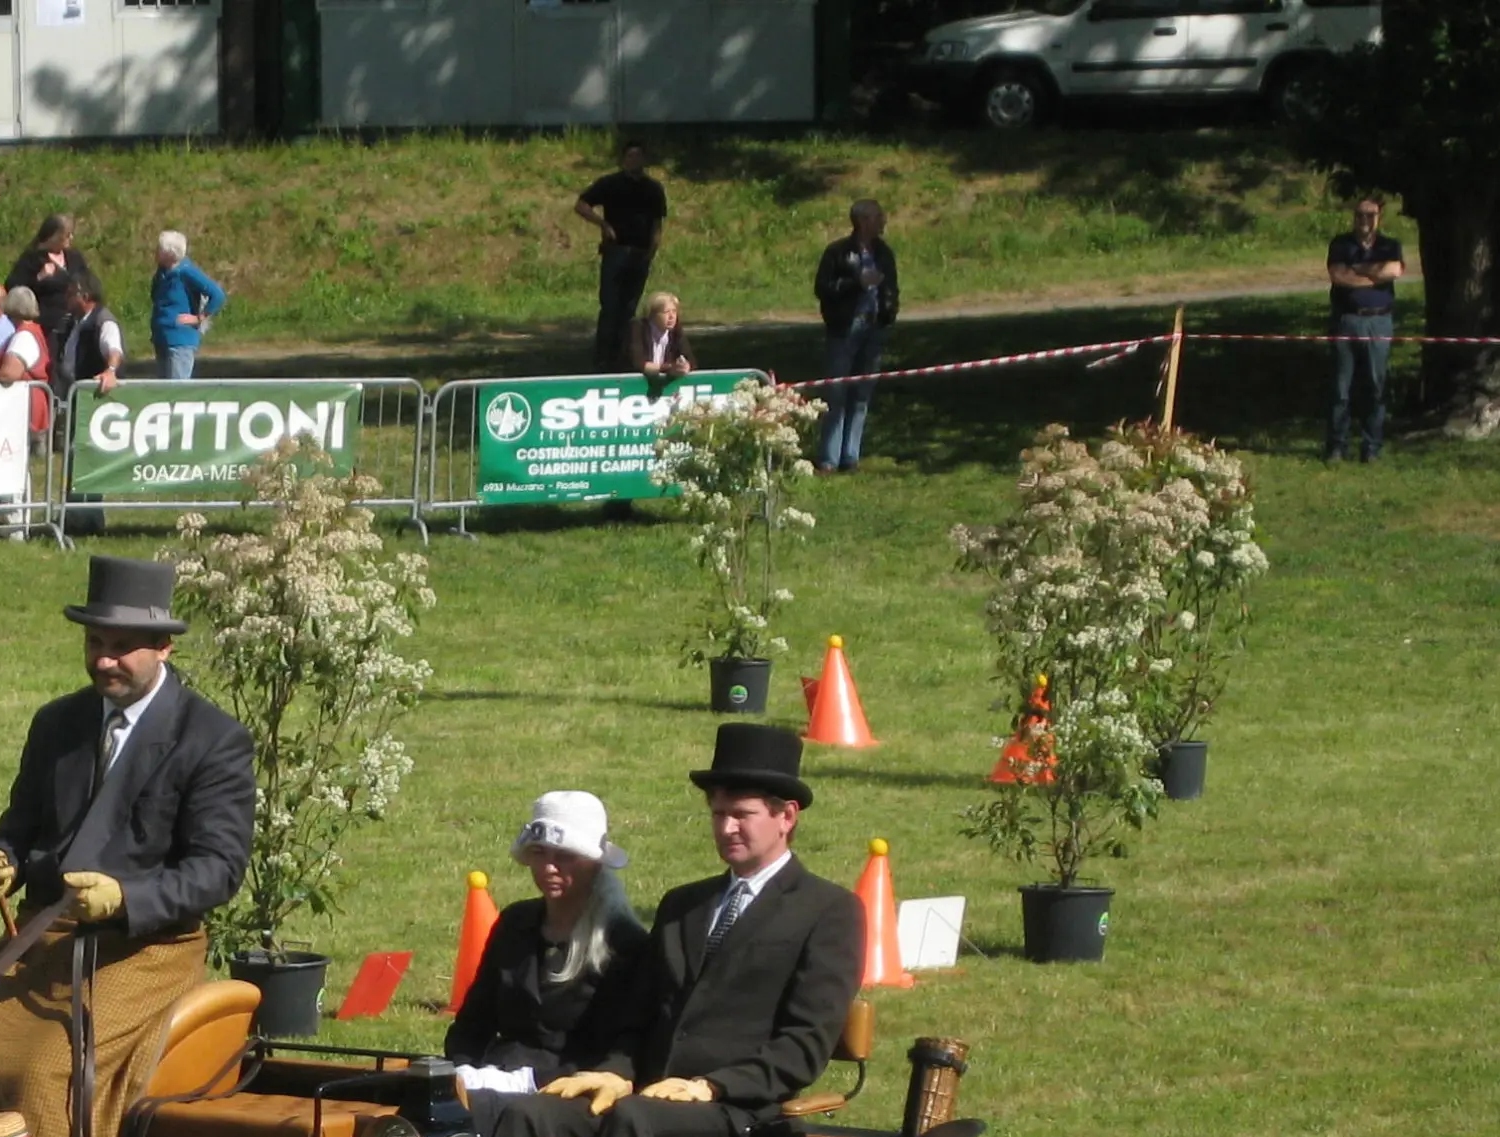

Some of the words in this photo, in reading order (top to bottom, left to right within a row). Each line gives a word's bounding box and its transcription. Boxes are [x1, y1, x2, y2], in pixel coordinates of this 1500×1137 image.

[89, 400, 346, 457] GATTONI
[516, 445, 606, 460] COSTRUZIONE
[608, 445, 616, 457] E
[528, 462, 588, 475] GIARDINI
[590, 461, 598, 473] E
[600, 459, 644, 473] CAMPI
